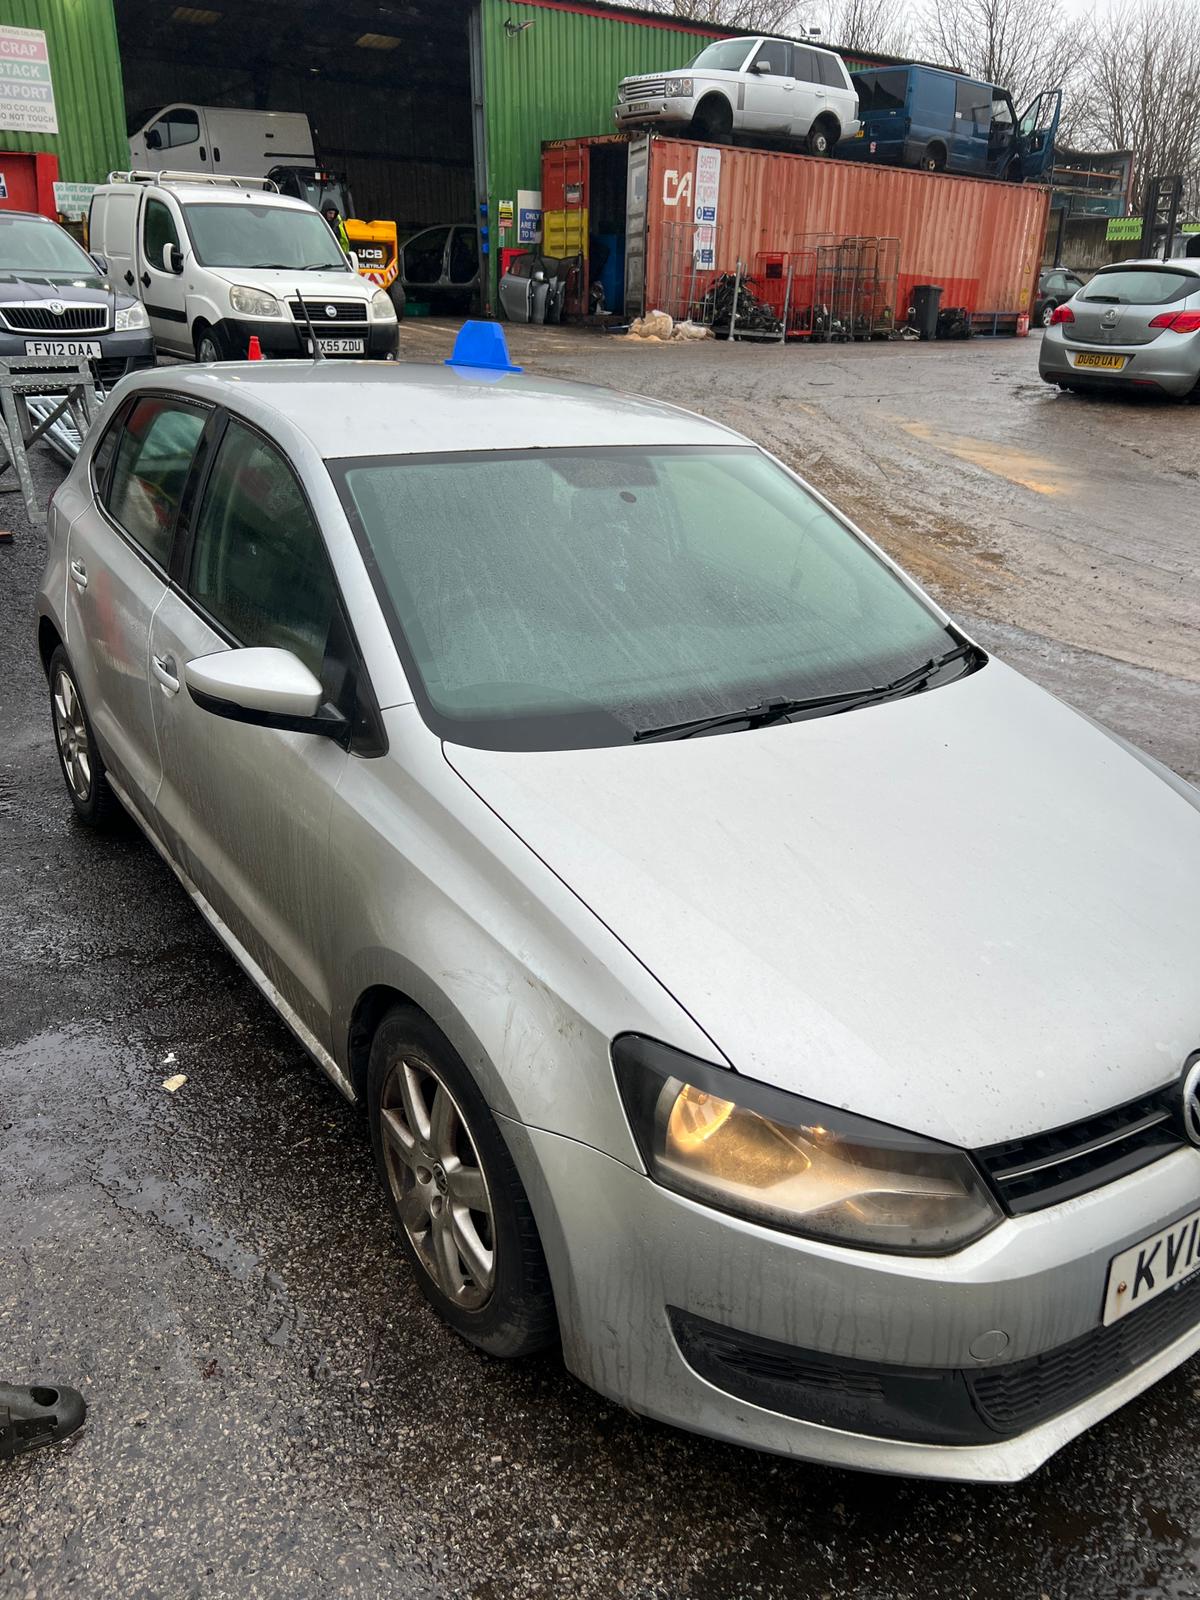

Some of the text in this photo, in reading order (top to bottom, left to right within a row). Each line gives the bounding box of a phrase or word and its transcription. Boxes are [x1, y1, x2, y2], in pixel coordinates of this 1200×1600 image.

[9, 112, 25, 120] NOT
[28, 114, 55, 122] TOUCH
[358, 248, 382, 258] JCB
[34, 343, 93, 356] FV12 OAA
[316, 340, 360, 352] X55 ZDU
[1078, 354, 1120, 366] DU60 UAV
[1131, 1218, 1200, 1300] KV1
